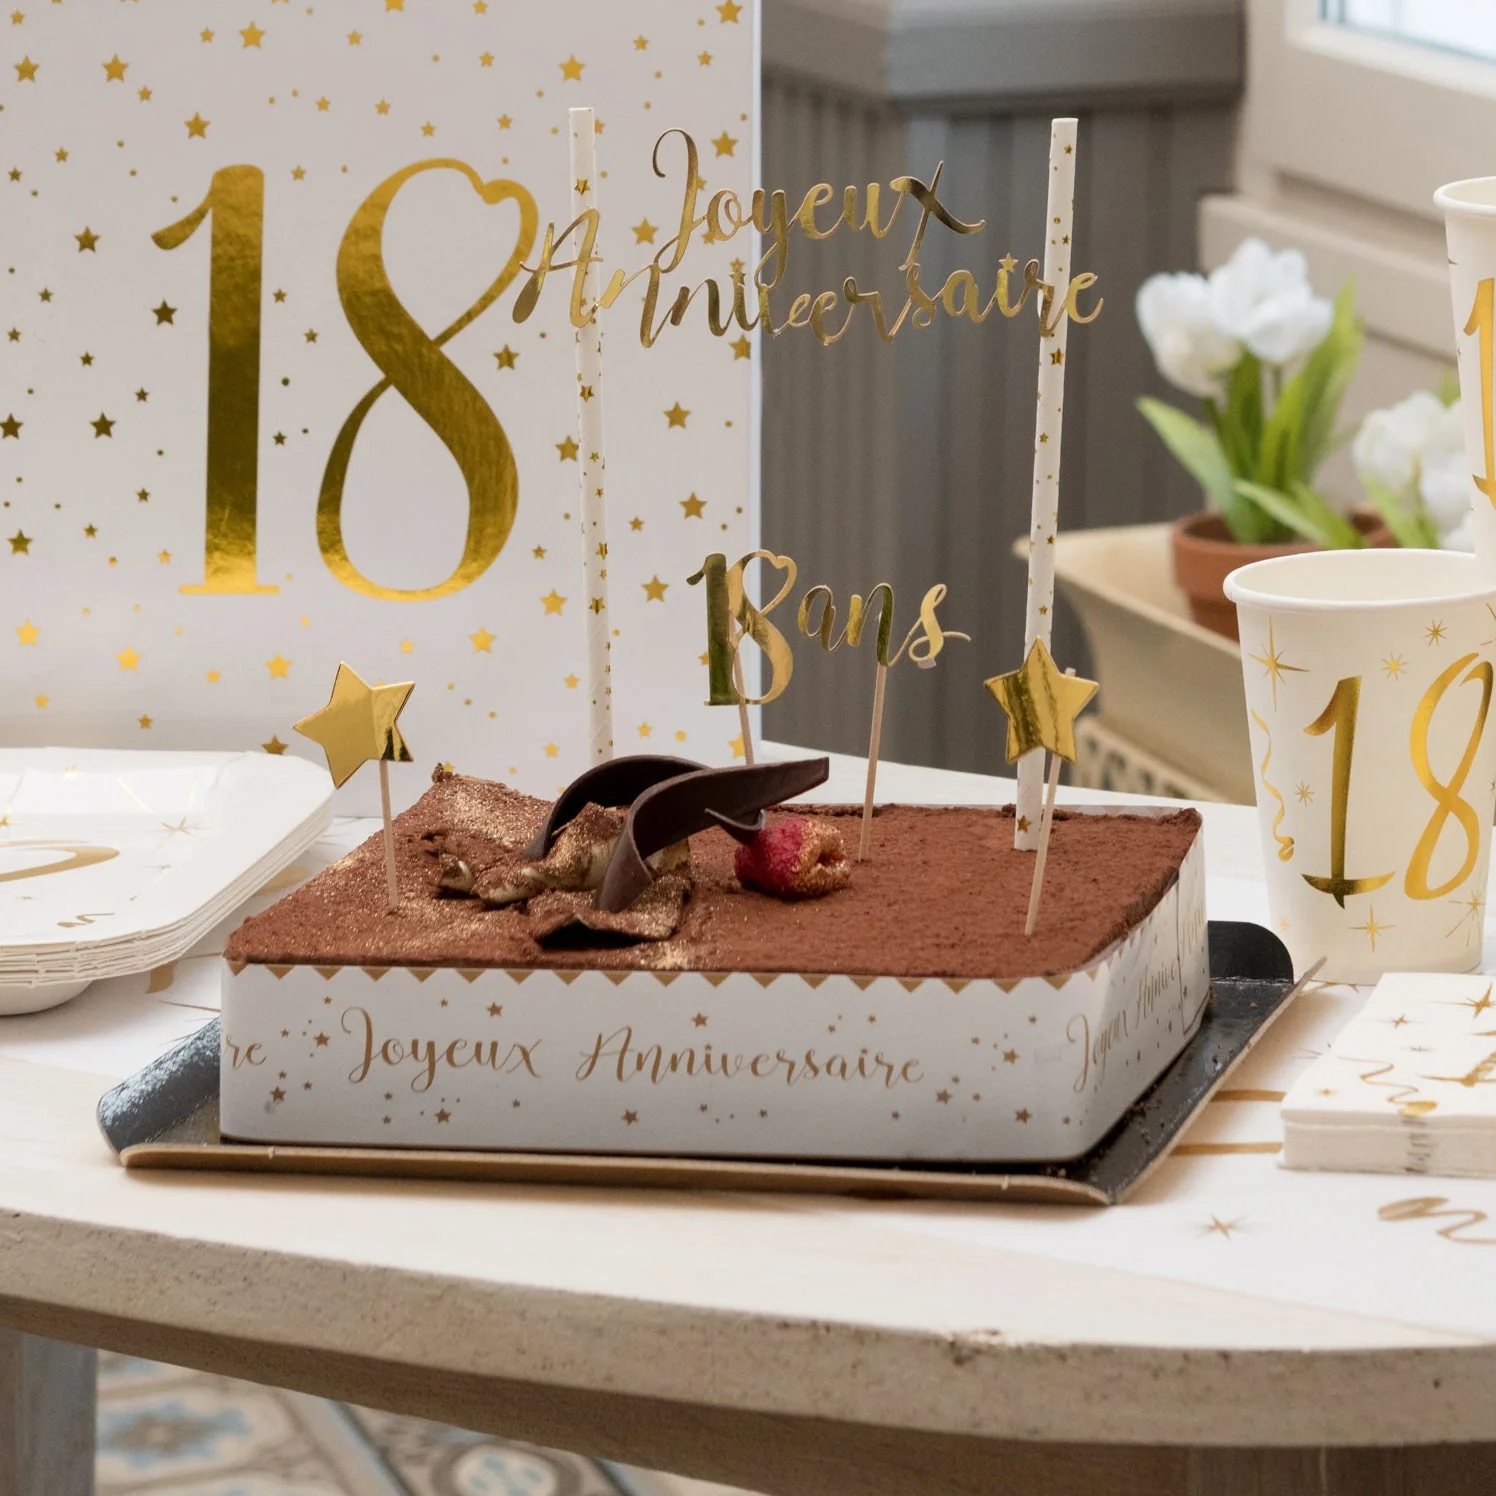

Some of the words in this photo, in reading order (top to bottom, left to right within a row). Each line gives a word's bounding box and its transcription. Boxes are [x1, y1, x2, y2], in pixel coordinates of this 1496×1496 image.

[512, 207, 1104, 349] Anniversaire
[653, 127, 986, 290] Joyeux
[150, 157, 539, 603] 18
[686, 549, 798, 706] 18
[797, 582, 971, 668] ans
[1301, 651, 1495, 907] 18
[341, 1006, 543, 1093] Joyeux
[575, 1026, 926, 1088] Anniversaire
